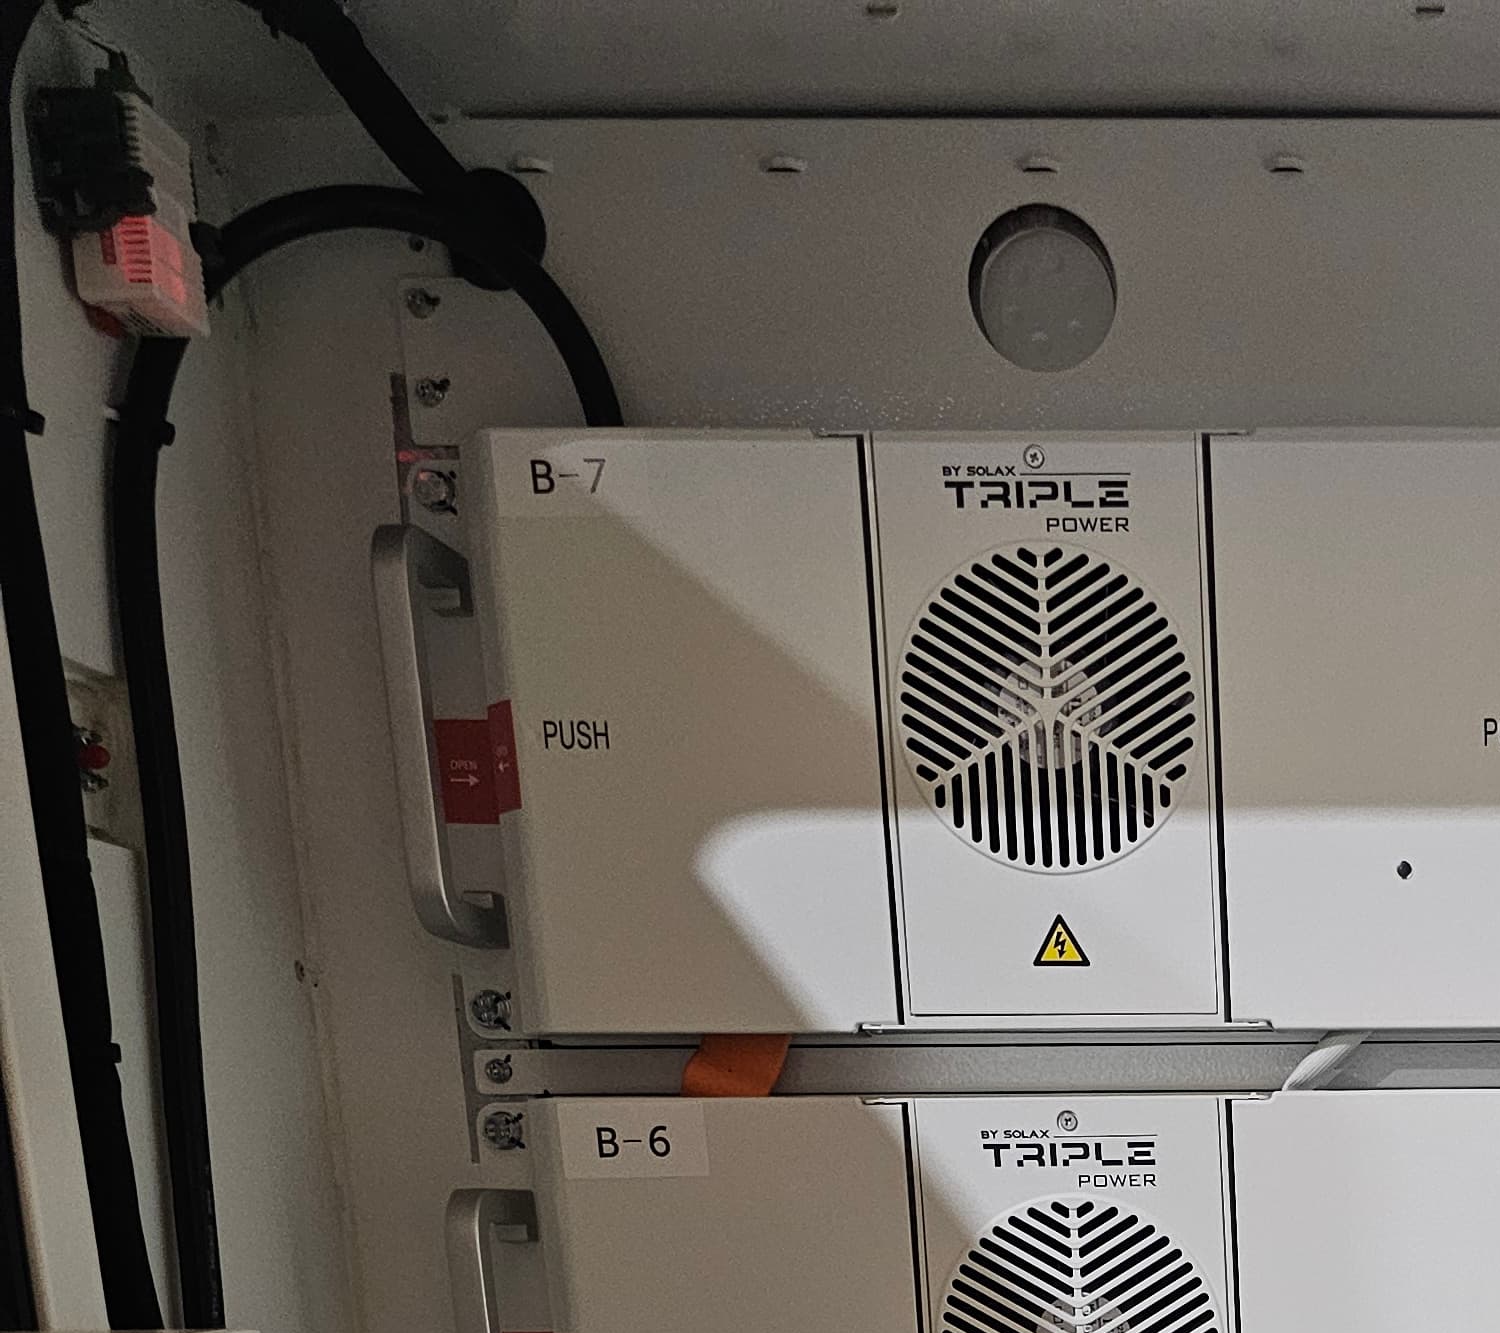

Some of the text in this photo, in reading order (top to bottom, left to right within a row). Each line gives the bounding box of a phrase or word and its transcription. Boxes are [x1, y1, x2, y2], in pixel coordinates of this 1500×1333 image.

[530, 457, 606, 494] B-7
[942, 465, 1016, 476] BY SOLAX
[944, 480, 1129, 508] TRIPLE
[1046, 517, 1130, 533] POWER
[543, 720, 610, 750] PUSH
[595, 1125, 672, 1159] B-6
[980, 1129, 1050, 1140] BY SOLAX
[983, 1141, 1156, 1167] TRIPLE
[1078, 1174, 1157, 1188] POWER
